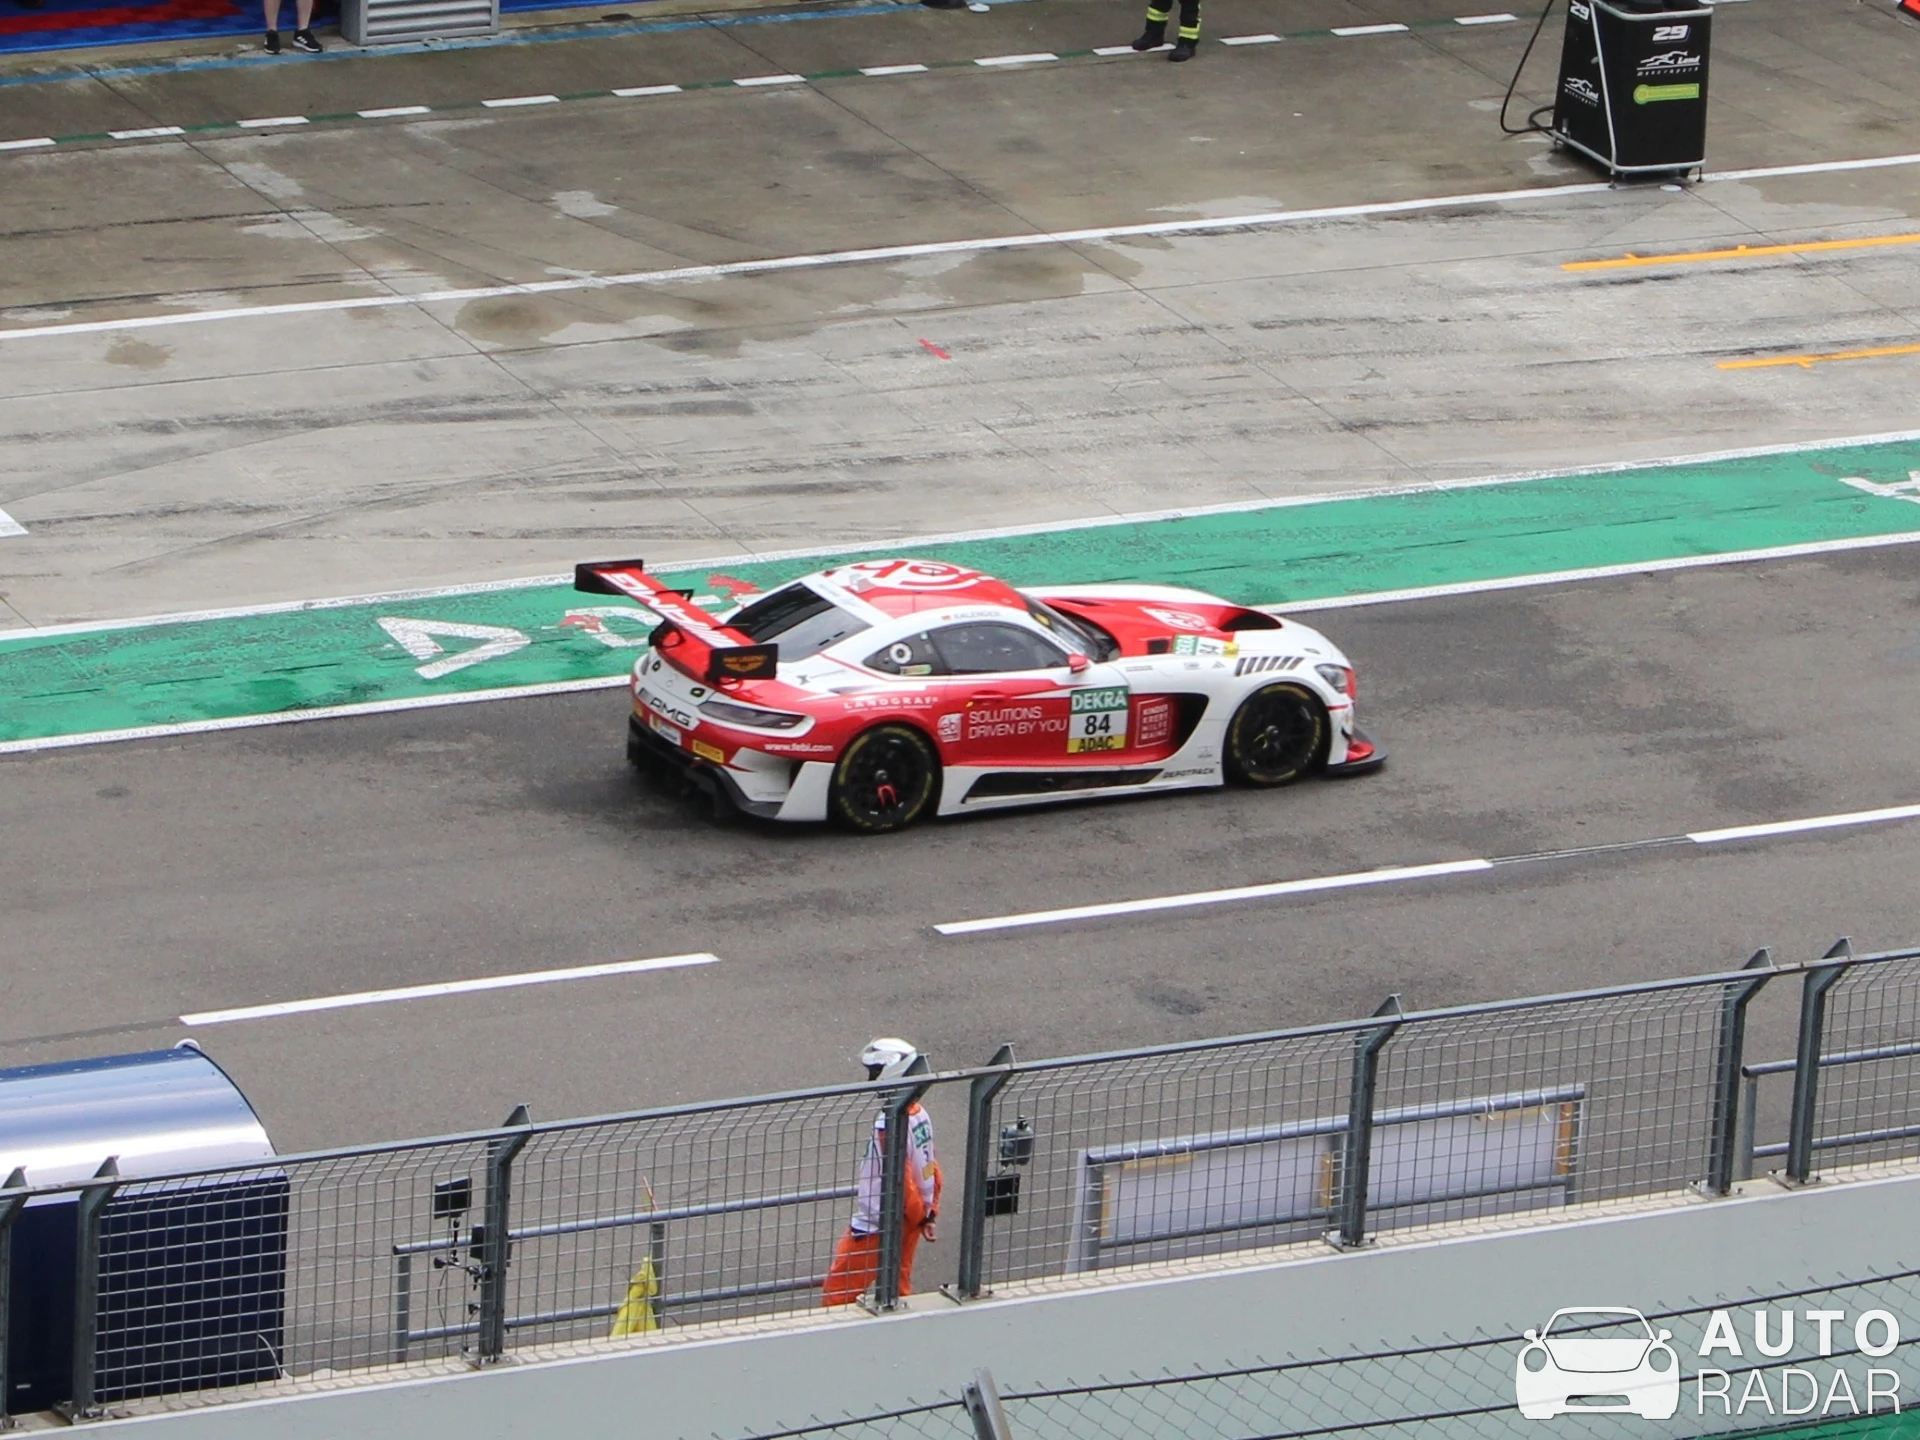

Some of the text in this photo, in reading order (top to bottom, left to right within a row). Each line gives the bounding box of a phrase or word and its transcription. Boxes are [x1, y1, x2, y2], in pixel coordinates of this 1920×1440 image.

[1570, 1, 1590, 20] 29
[1652, 25, 1689, 41] 29
[1072, 690, 1127, 710] DEKRA
[650, 697, 691, 727] AMG
[969, 706, 1042, 724] SOLUTIONS
[968, 723, 1015, 739] DRIVEN
[1018, 720, 1037, 735] BY
[1038, 718, 1068, 733] YOU
[1085, 714, 1111, 736] 84
[1078, 736, 1115, 751] ADAC
